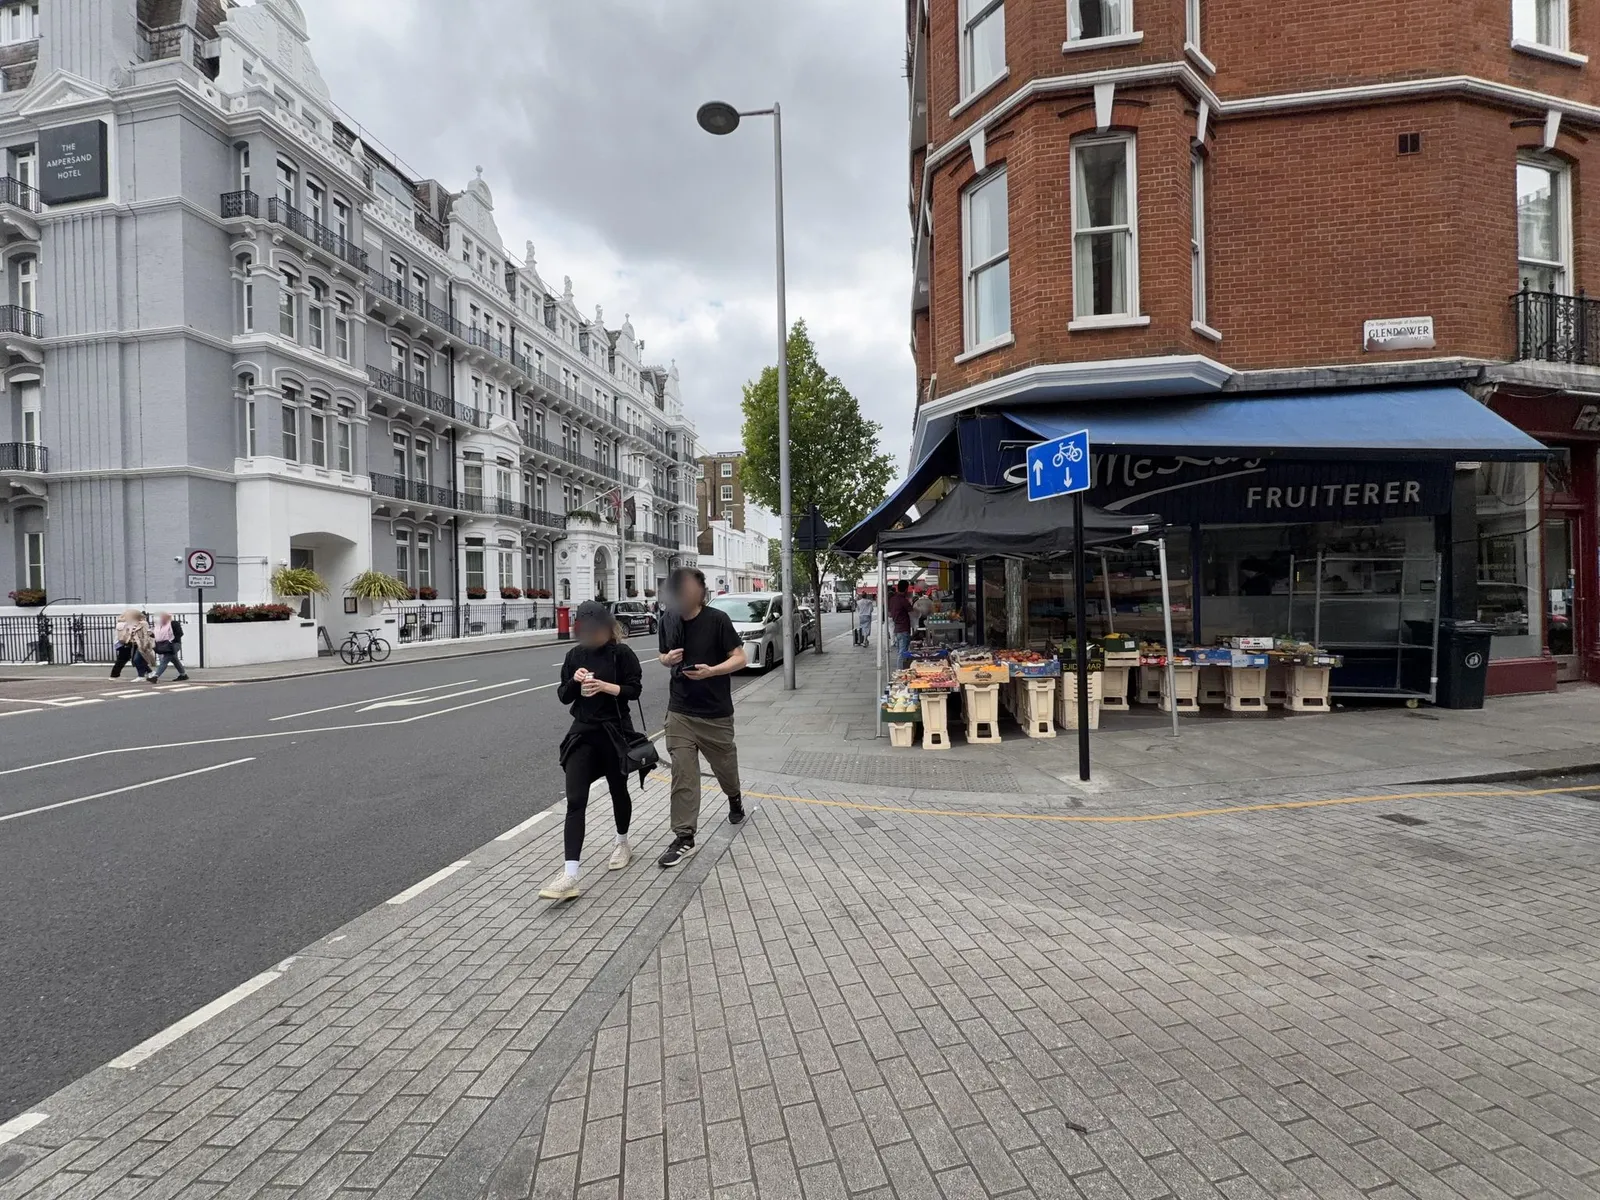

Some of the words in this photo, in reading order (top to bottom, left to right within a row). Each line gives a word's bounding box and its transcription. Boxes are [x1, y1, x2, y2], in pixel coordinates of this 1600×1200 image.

[62, 143, 76, 151] THE
[46, 153, 92, 168] AMPERSAND
[58, 169, 81, 179] HOTEL
[1246, 480, 1421, 508] FRUITERER
[1062, 662, 1101, 671] EJIDAR
